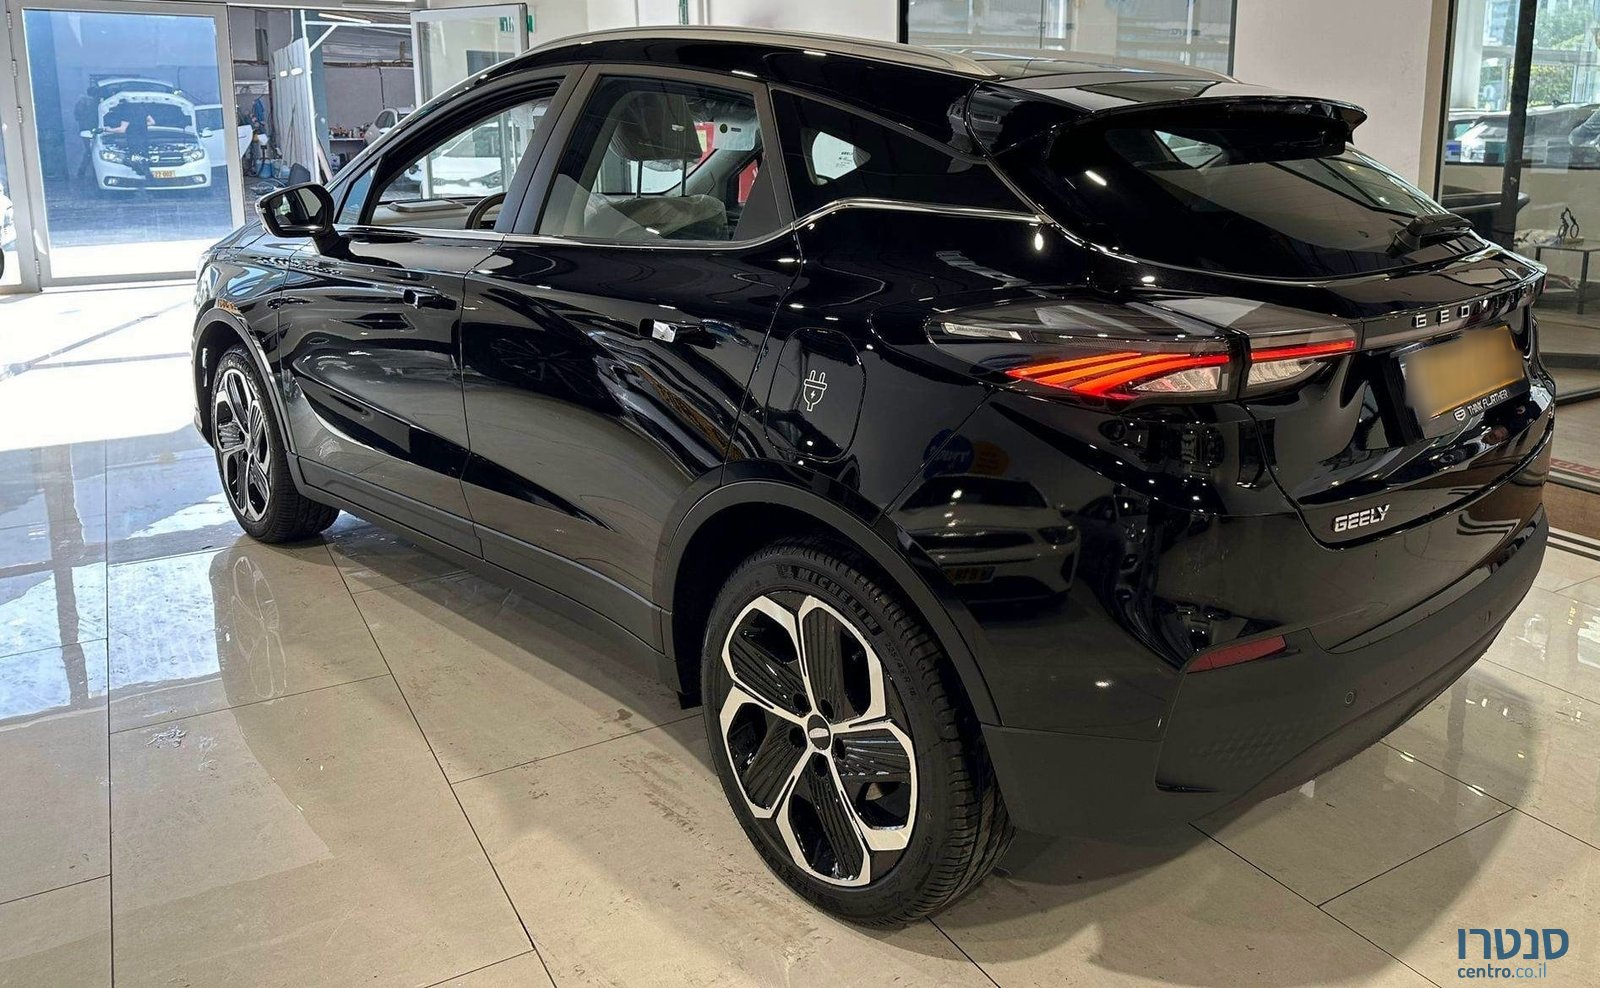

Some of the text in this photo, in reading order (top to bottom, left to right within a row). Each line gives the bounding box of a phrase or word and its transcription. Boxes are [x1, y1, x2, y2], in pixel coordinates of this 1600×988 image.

[1467, 389, 1508, 415] THINK FURTHER
[1334, 504, 1390, 532] GEELY
[796, 567, 880, 630] MICHELIN
